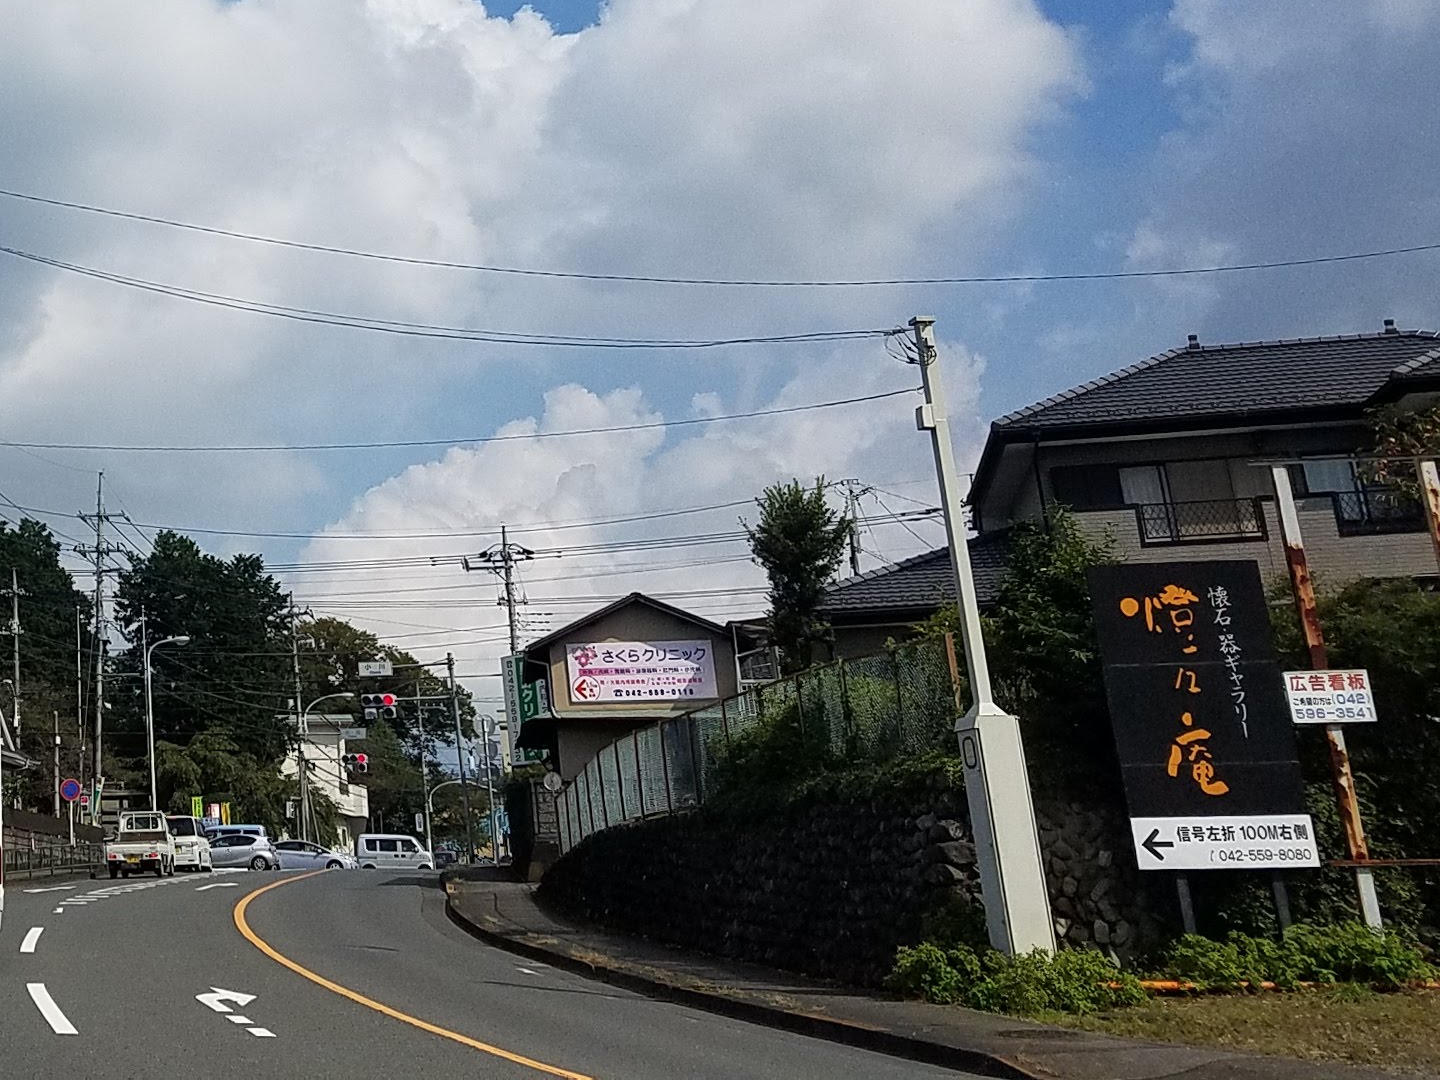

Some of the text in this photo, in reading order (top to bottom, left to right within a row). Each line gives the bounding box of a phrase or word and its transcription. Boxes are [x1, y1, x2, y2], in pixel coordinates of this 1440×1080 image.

[602, 647, 707, 663] さくらクリニック
[1289, 673, 1366, 692] 広告看板
[1295, 707, 1373, 719] 596-3541
[1176, 825, 1235, 842] 信号左折
